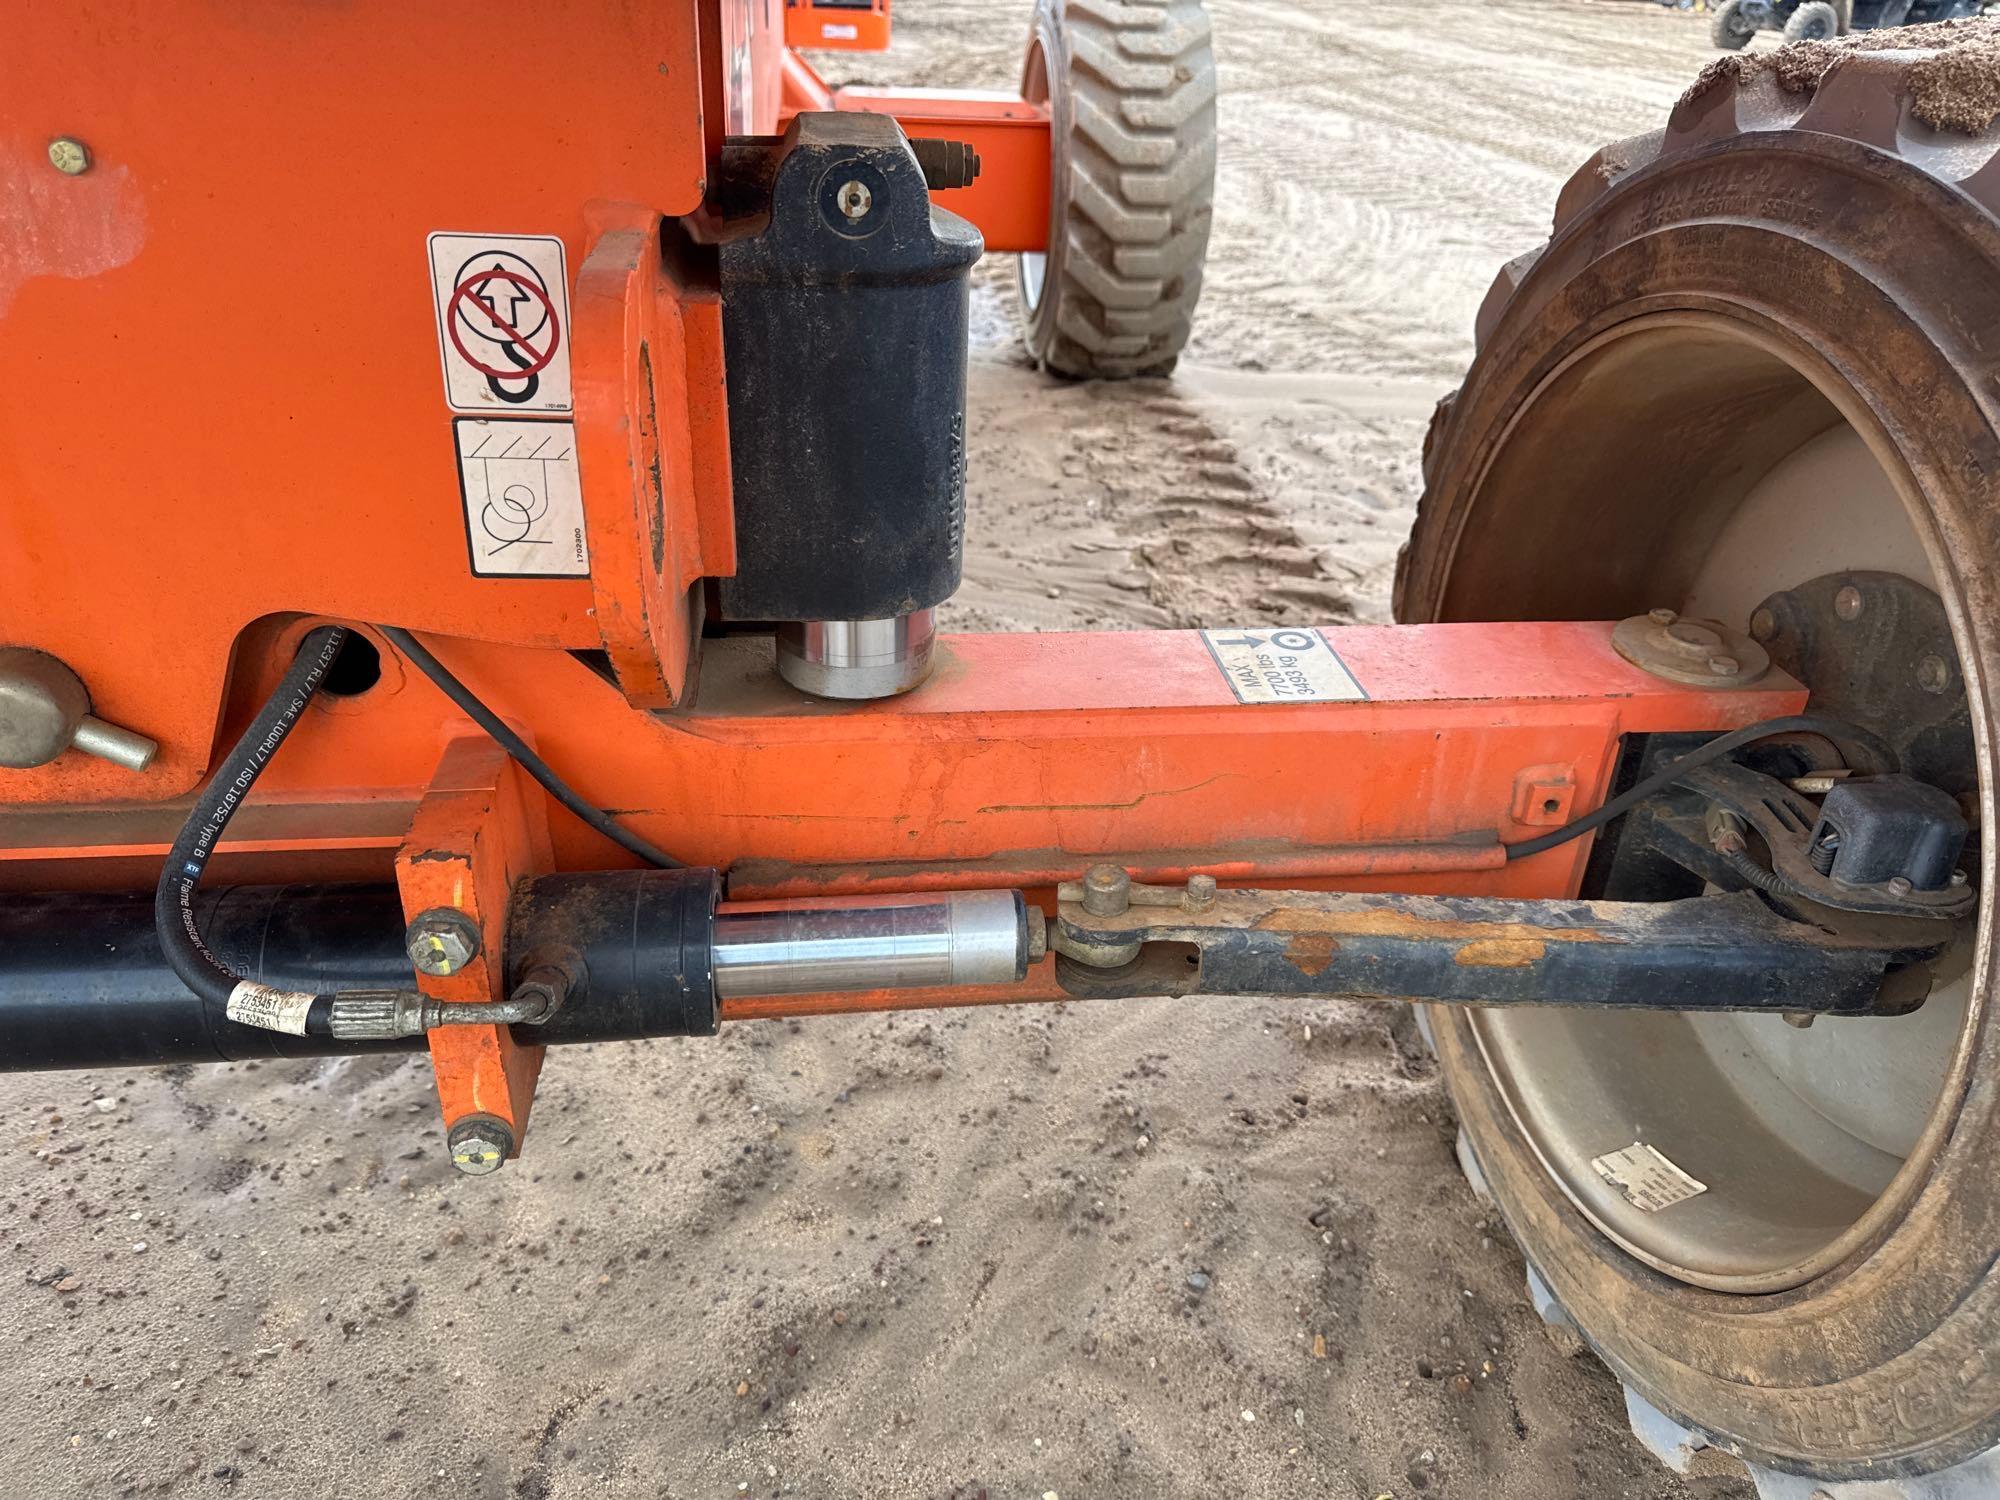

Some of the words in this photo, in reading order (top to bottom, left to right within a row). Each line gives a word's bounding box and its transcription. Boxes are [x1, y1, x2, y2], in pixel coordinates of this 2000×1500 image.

[574, 527, 584, 563] 1702300
[318, 631, 342, 668] 11237
[1256, 653, 1276, 669] lbs
[1278, 655, 1298, 668] kg
[304, 667, 323, 692] R17
[1263, 671, 1293, 696] 7700
[1285, 670, 1316, 696] 3493
[283, 698, 304, 720] SAE
[255, 719, 288, 762] 100R17
[235, 767, 255, 788] ISO
[212, 786, 241, 823] 18752
[198, 823, 220, 849] Type
[193, 848, 206, 858] B
[186, 863, 200, 873] XTF
[180, 877, 194, 907] Flame
[181, 907, 206, 949] Resistant
